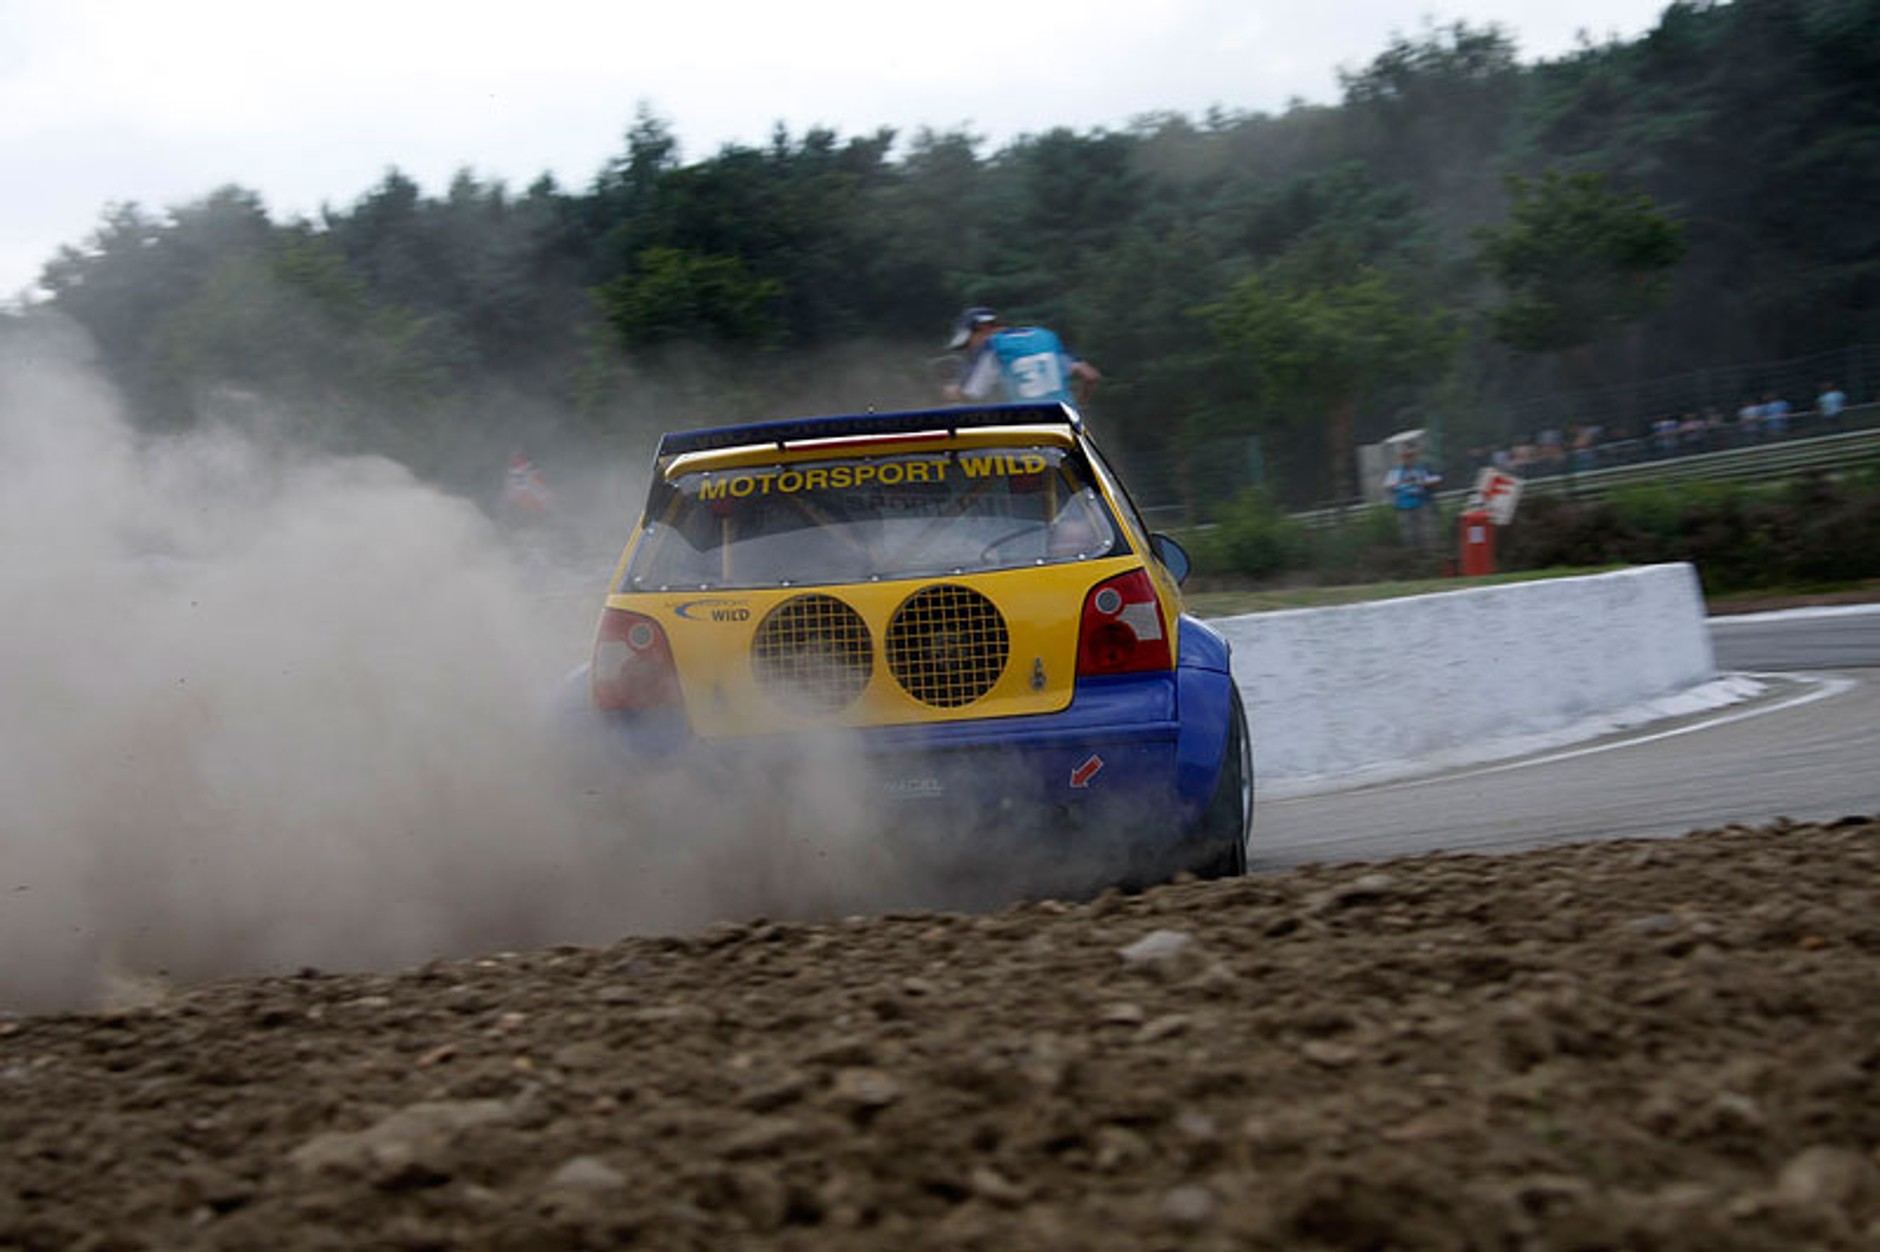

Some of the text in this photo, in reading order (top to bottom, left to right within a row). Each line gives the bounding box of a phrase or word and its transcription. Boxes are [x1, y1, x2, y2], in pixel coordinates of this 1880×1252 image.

[698, 454, 1049, 501] MOTORSPORT WILD
[711, 607, 750, 622] WILD
